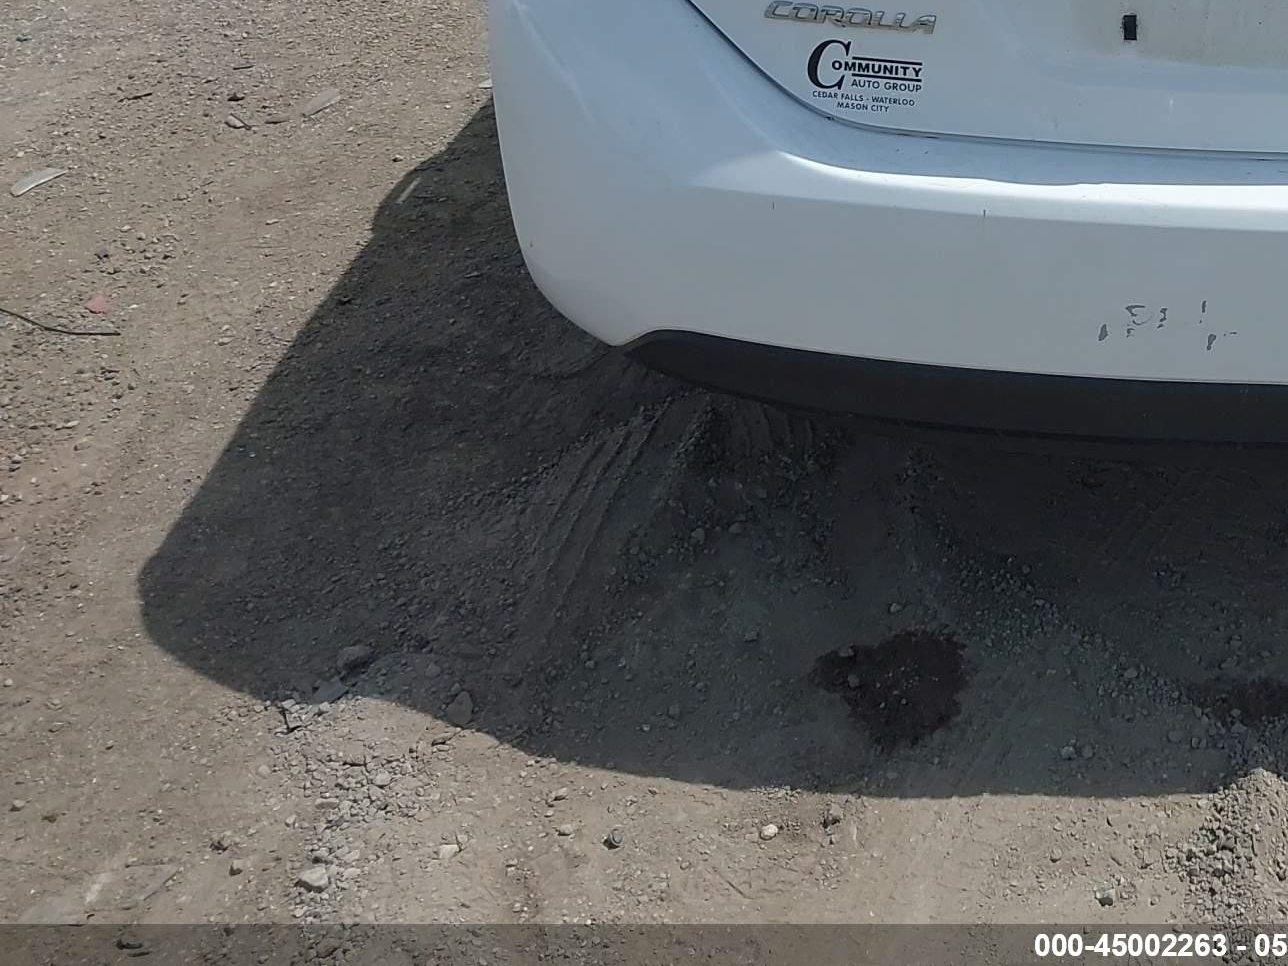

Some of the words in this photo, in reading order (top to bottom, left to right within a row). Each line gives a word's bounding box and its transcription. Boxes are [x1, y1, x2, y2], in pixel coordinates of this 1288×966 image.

[764, 0, 938, 35] COROLLA
[807, 39, 923, 90] COMMUNITY
[851, 78, 880, 89] AUTO
[884, 81, 922, 93] GROUP
[812, 90, 839, 99] CEDAR
[841, 93, 864, 102] FALLS
[871, 95, 915, 107] WATERLOO
[836, 101, 868, 111] MASON
[871, 104, 890, 113] CITY
